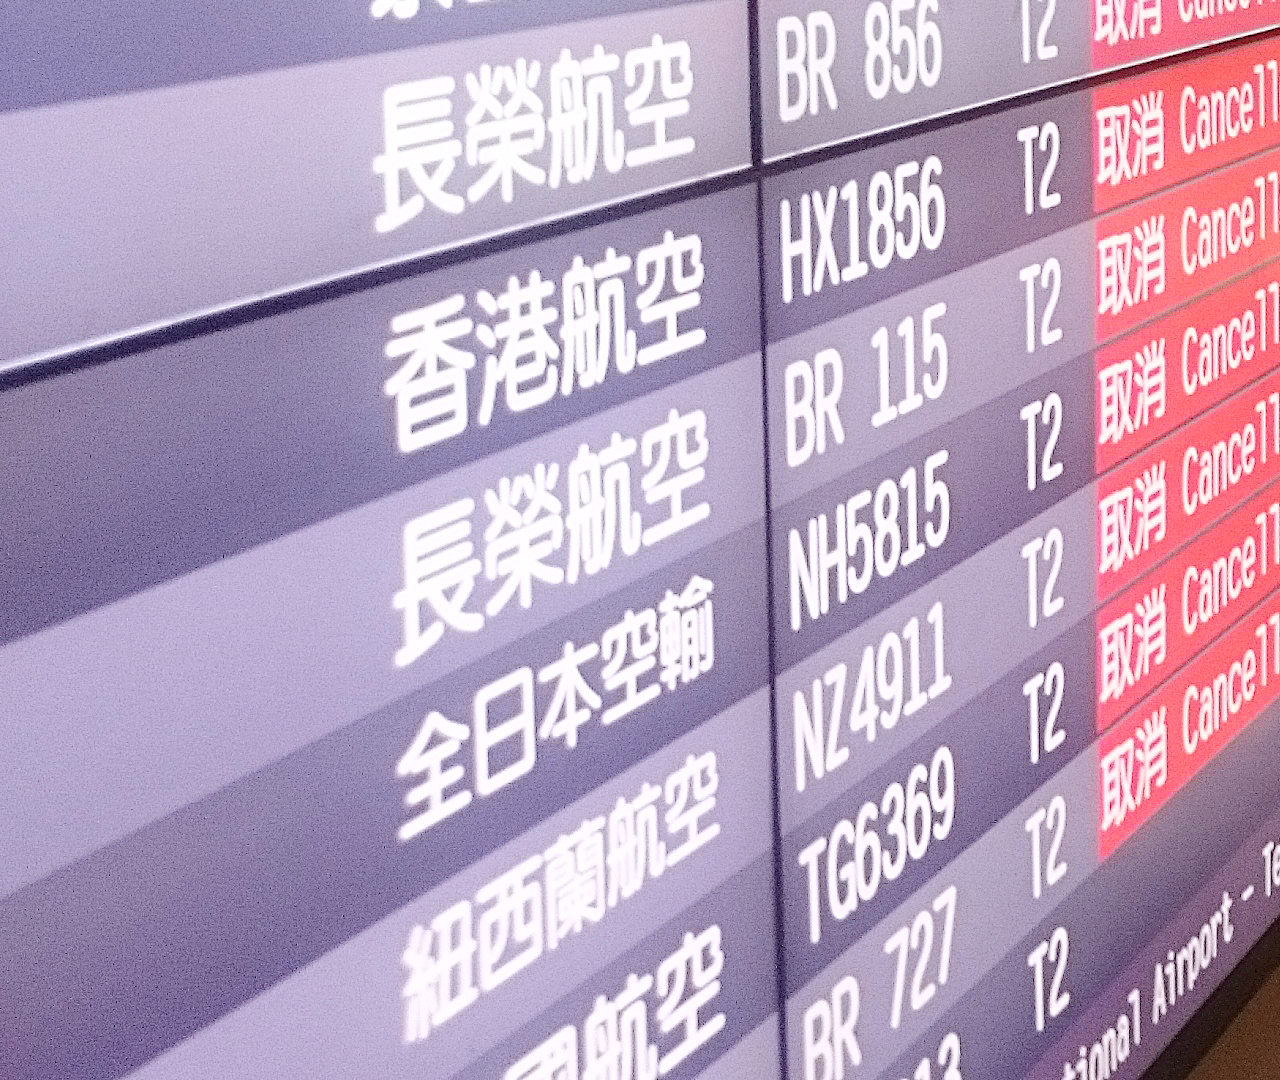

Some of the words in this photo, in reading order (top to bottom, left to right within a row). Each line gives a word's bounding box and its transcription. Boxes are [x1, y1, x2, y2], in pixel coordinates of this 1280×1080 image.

[373, 33, 696, 233] 長榮航空
[776, 10, 838, 123] BR
[383, 230, 707, 454] 香港航空
[780, 155, 945, 304] HX1856
[1017, 121, 1061, 213] T2
[1096, 90, 1164, 186] 取消
[392, 408, 711, 668] 長榮航空
[784, 348, 844, 468] BR
[870, 302, 947, 429] 115
[1020, 258, 1063, 354] T2
[1097, 215, 1165, 316] 取消
[396, 575, 715, 842] 全日本空輸
[788, 449, 950, 632] NH5815
[1020, 392, 1064, 491] T2
[1098, 337, 1166, 445] 取消
[401, 751, 720, 1045] 紐西蘭航空
[793, 602, 952, 793] NZ4911
[1022, 528, 1065, 629] T2
[1099, 460, 1166, 574] 取消
[500, 923, 726, 1080] 國航空
[798, 747, 955, 944] TG6369
[1023, 662, 1066, 765] T2
[1099, 583, 1167, 704] 取消
[803, 976, 863, 1080] BR
[884, 886, 957, 1029] 727
[1025, 796, 1068, 899] T2
[1100, 705, 1168, 832] 取消
[1028, 927, 1070, 1032] T2
[1152, 890, 1234, 1025] Airport
